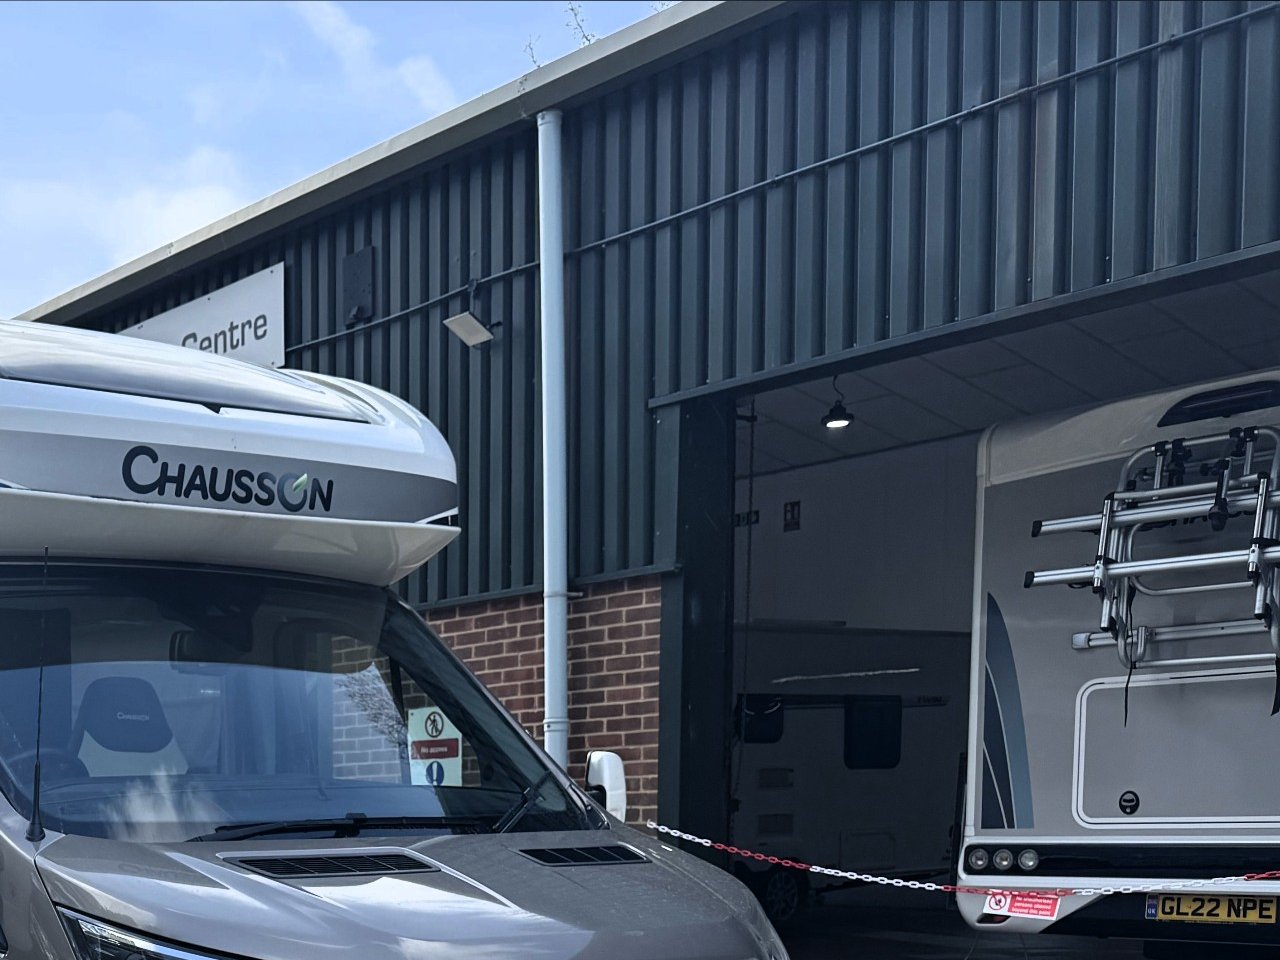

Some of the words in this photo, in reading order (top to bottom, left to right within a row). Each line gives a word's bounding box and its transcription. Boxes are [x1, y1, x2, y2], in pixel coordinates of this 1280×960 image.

[122, 445, 333, 512] CHAUSSON
[1161, 896, 1221, 917] GL22
[1227, 898, 1273, 919] NPE
